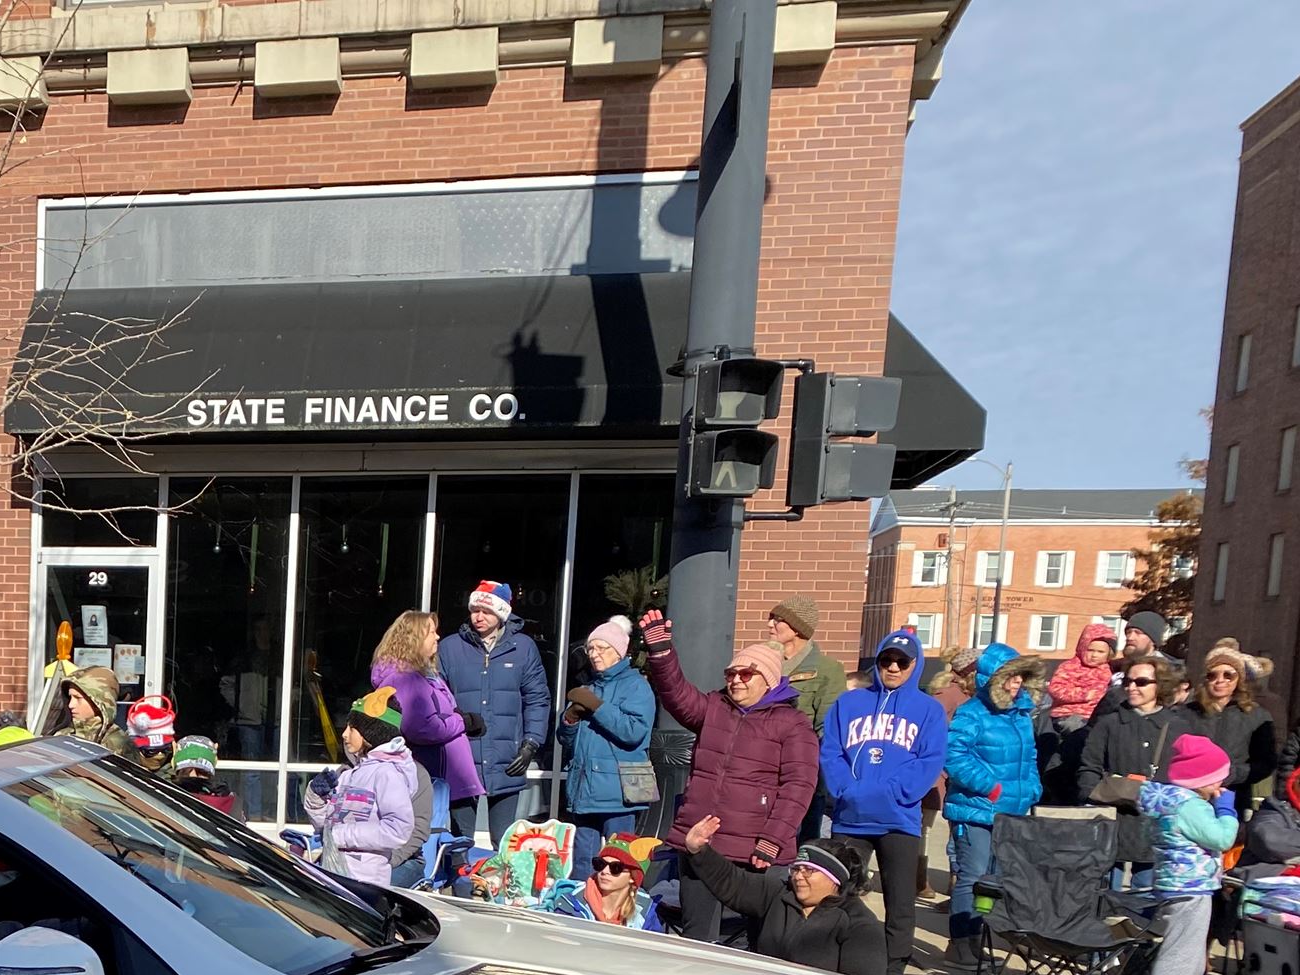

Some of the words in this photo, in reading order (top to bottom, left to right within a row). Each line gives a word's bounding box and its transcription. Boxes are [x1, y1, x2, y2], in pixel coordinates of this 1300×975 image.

[187, 398, 285, 426] STATE
[305, 395, 449, 424] FINANCE
[469, 393, 526, 420] CO.
[88, 571, 108, 585] 29
[846, 713, 919, 752] KANSAS
